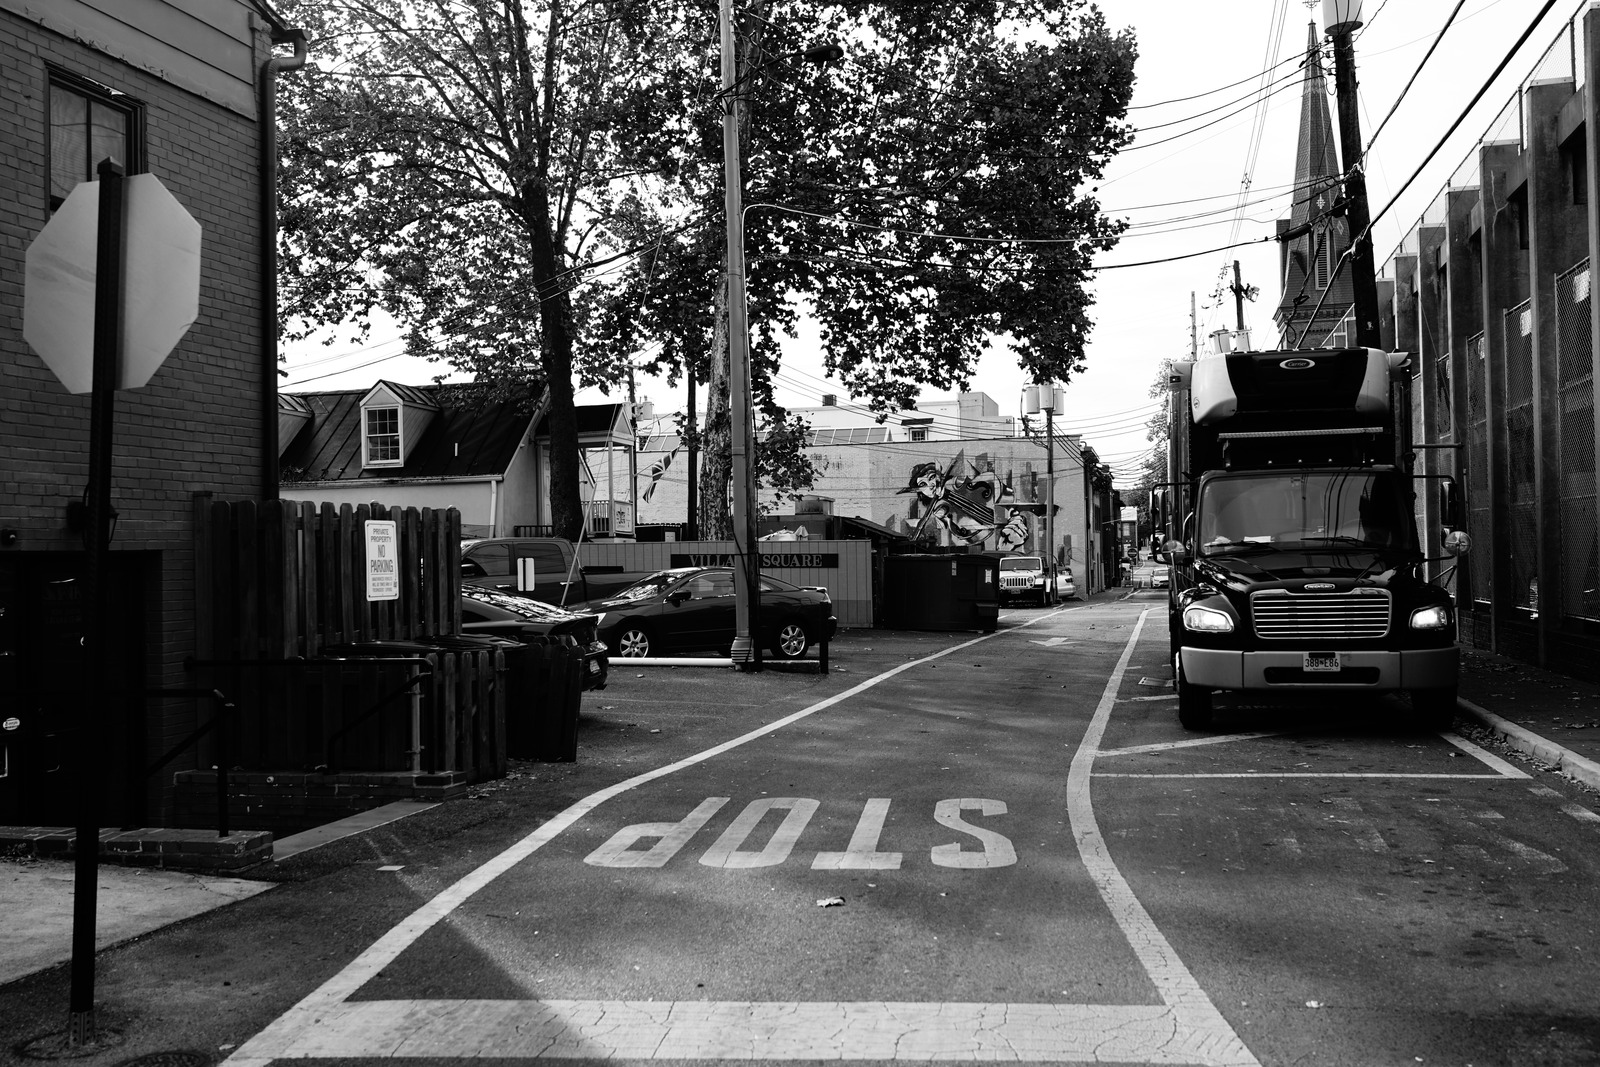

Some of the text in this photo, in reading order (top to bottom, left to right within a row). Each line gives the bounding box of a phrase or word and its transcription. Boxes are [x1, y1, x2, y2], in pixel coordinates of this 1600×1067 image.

[372, 528, 389, 536] PRIVATE
[370, 535, 392, 543] PROPERTY
[377, 544, 386, 558] NO
[370, 559, 394, 573] PARKING
[688, 554, 823, 567] VILLA SQUARE
[583, 797, 1018, 869] STOP
